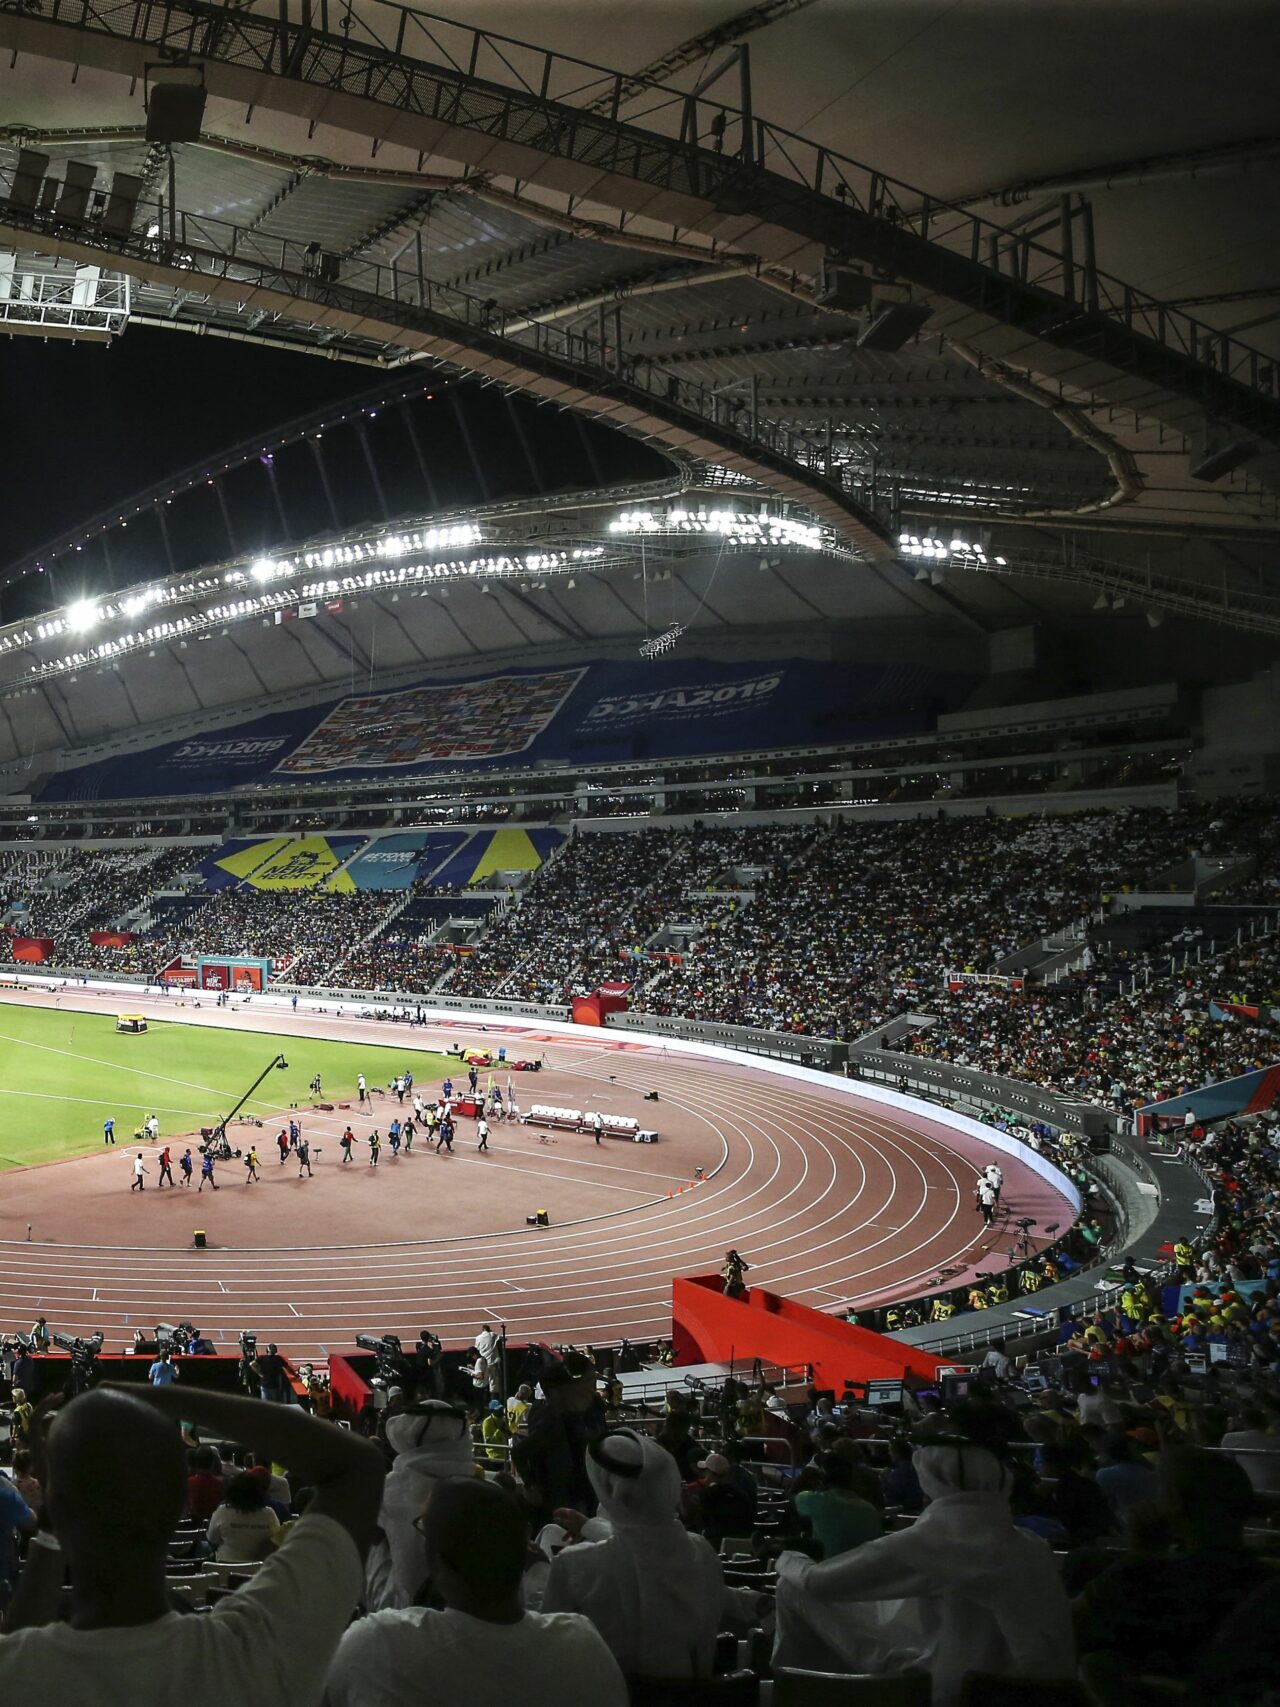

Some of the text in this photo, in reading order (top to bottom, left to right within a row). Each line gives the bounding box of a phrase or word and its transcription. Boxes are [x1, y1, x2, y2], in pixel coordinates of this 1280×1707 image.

[585, 677, 781, 718] DOHA2019
[169, 739, 287, 757] DOHA2019
[269, 865, 313, 874] NEW
